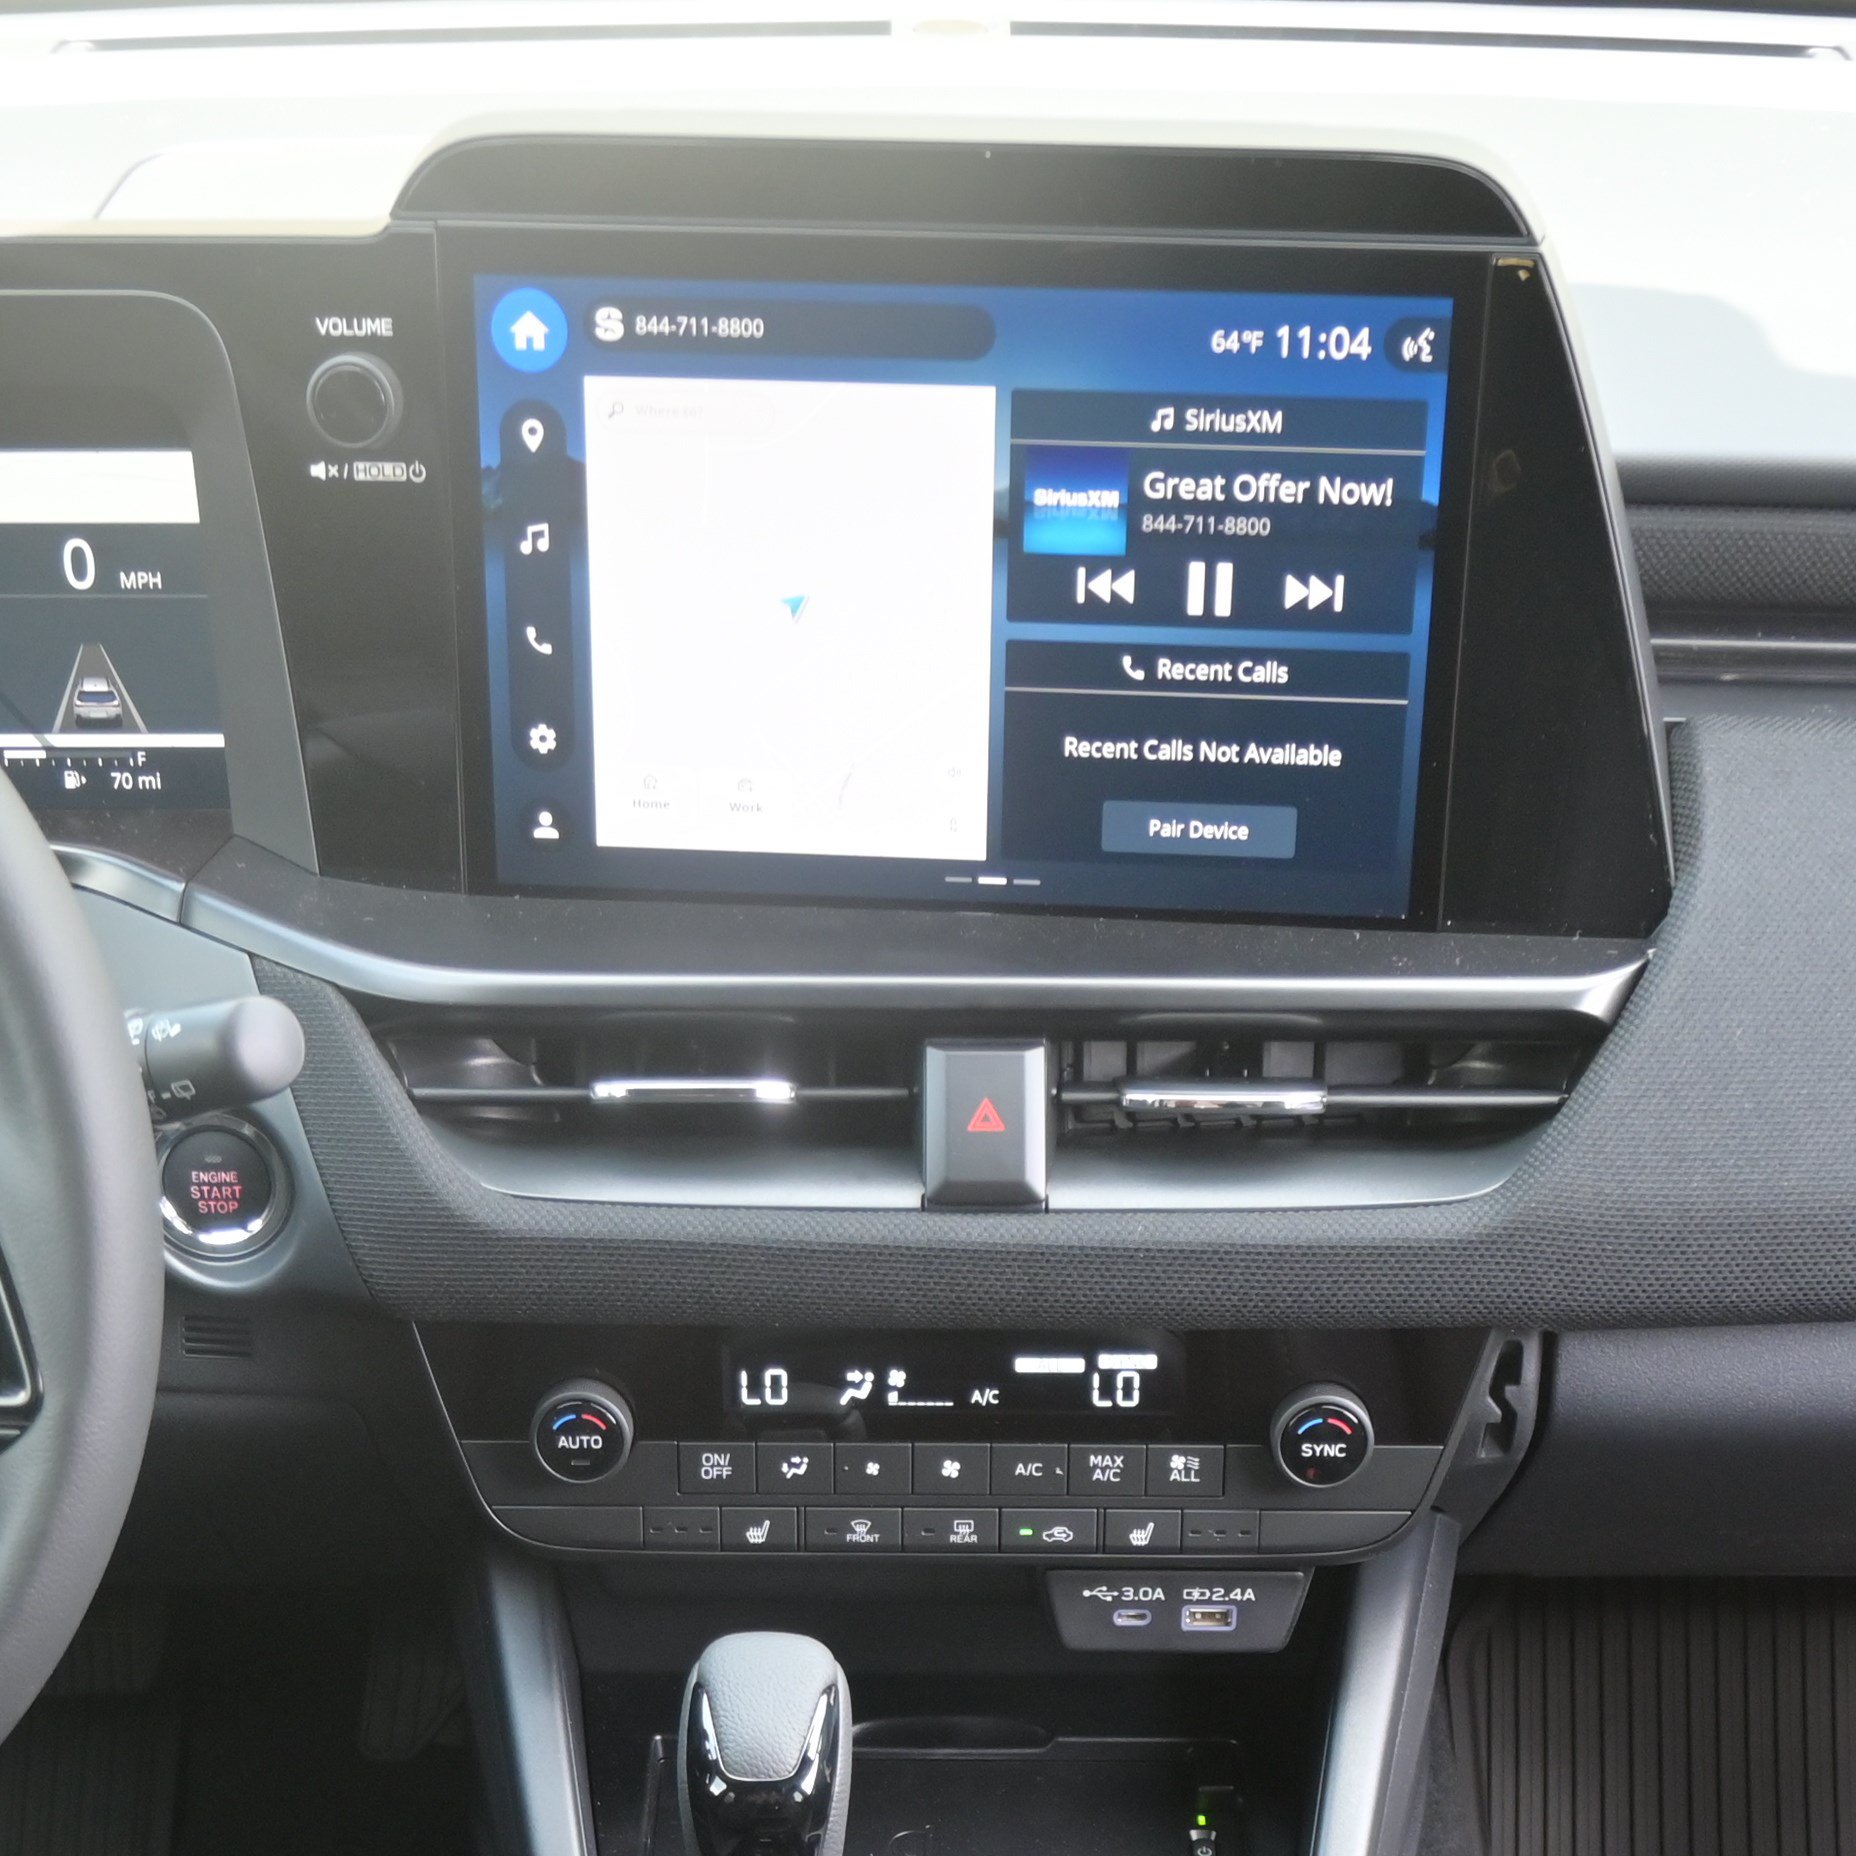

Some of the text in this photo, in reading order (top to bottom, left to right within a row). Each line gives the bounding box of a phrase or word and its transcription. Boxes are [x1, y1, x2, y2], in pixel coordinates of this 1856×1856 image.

[315, 316, 394, 338] VOLUME
[634, 315, 765, 339] 844-711-8800
[1275, 325, 1372, 360] 11:04
[1184, 409, 1284, 434] SiriusXM
[356, 463, 404, 479] HOLD
[1143, 472, 1394, 507] Great Offer Now!
[1032, 487, 1120, 509] SiriusXM
[1141, 514, 1271, 537] 844-711-8800
[62, 537, 162, 590] 0 MPH
[1156, 659, 1289, 685] Recent Calls
[136, 751, 147, 766] F
[1063, 737, 1342, 767] Recent Calls Not Available
[110, 771, 162, 790] 70 mi
[1148, 819, 1249, 841] Pair Device
[191, 1171, 239, 1184] ENGINE
[190, 1185, 242, 1200] START
[197, 1200, 239, 1214] STOP
[970, 1389, 1000, 1405] A/C
[557, 1435, 603, 1450] AUTO
[1300, 1443, 1348, 1459] SYNC
[701, 1453, 731, 1468] ON/
[1089, 1454, 1124, 1468] MAX
[700, 1466, 733, 1480] OFF
[1014, 1462, 1043, 1477] A/C
[1092, 1468, 1122, 1483] A/C
[1169, 1468, 1201, 1483] ALL
[846, 1532, 880, 1543] FRONT
[949, 1532, 979, 1543] REAR
[1120, 1587, 1166, 1601] 3.0A
[1211, 1587, 1256, 1602] 2.4A
